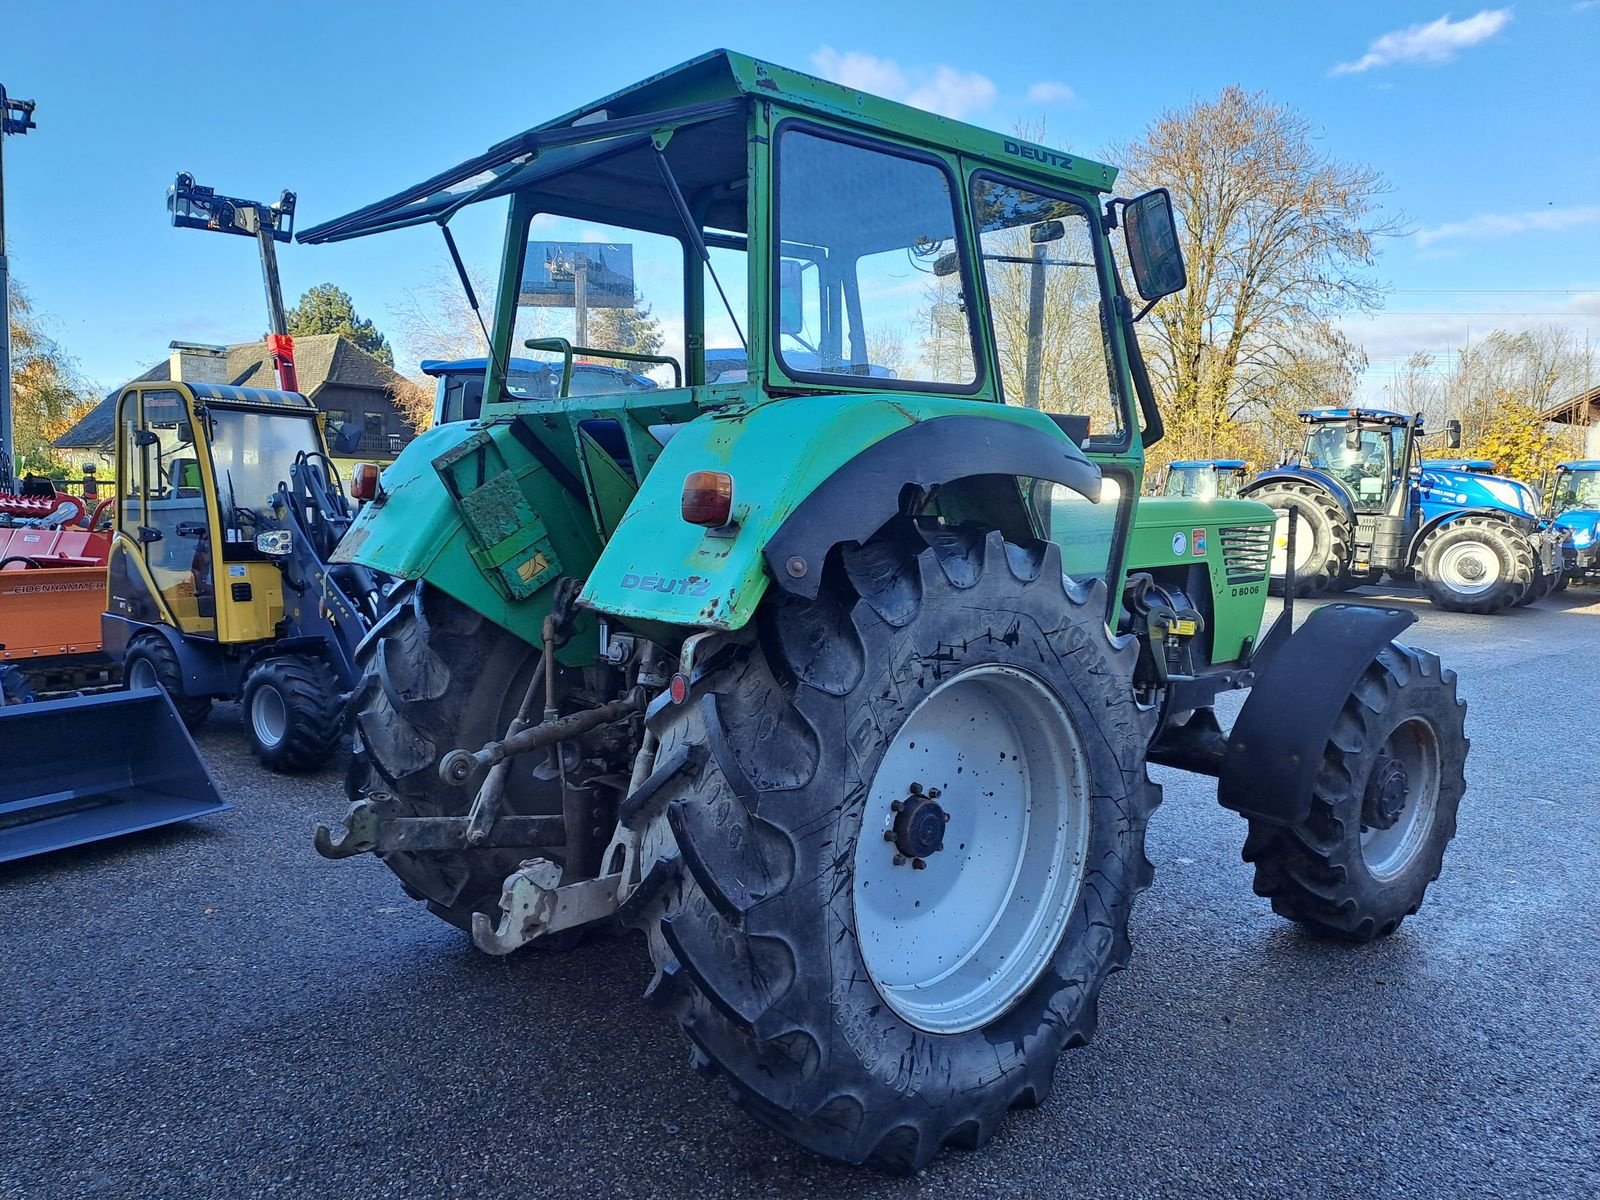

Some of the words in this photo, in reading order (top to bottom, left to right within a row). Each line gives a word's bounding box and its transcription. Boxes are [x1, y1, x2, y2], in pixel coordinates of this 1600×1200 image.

[1003, 140, 1073, 171] DEUTZ
[14, 582, 105, 594] EIDENHAMMER
[620, 574, 711, 597] DEUTZ
